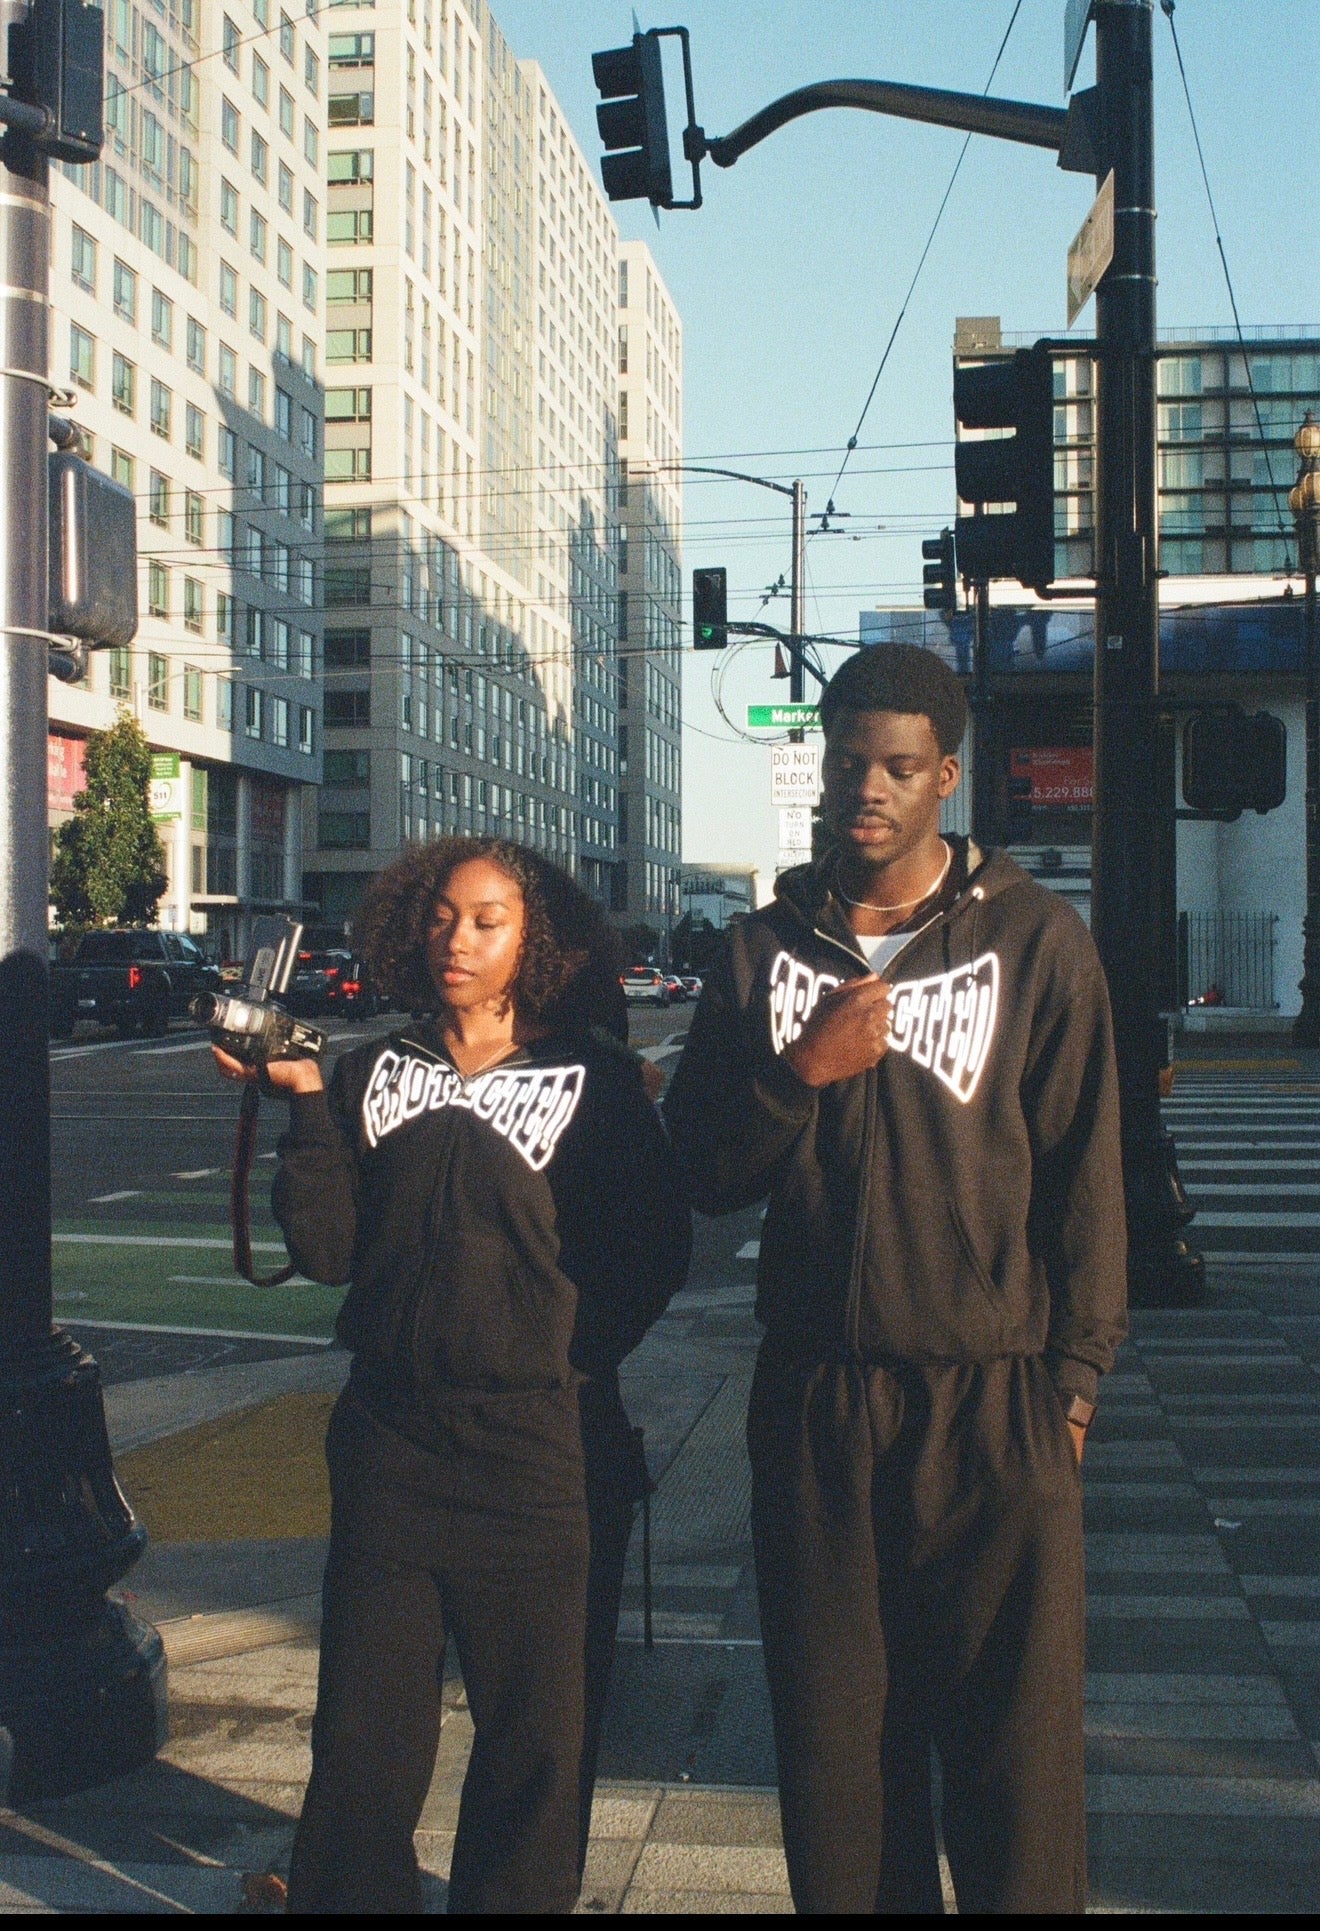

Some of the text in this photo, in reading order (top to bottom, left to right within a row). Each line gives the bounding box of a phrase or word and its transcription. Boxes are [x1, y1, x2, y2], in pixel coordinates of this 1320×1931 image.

[773, 752, 816, 765] DO NOT
[775, 772, 814, 785] BLOCK
[153, 791, 167, 800] 511
[787, 811, 802, 820] NO
